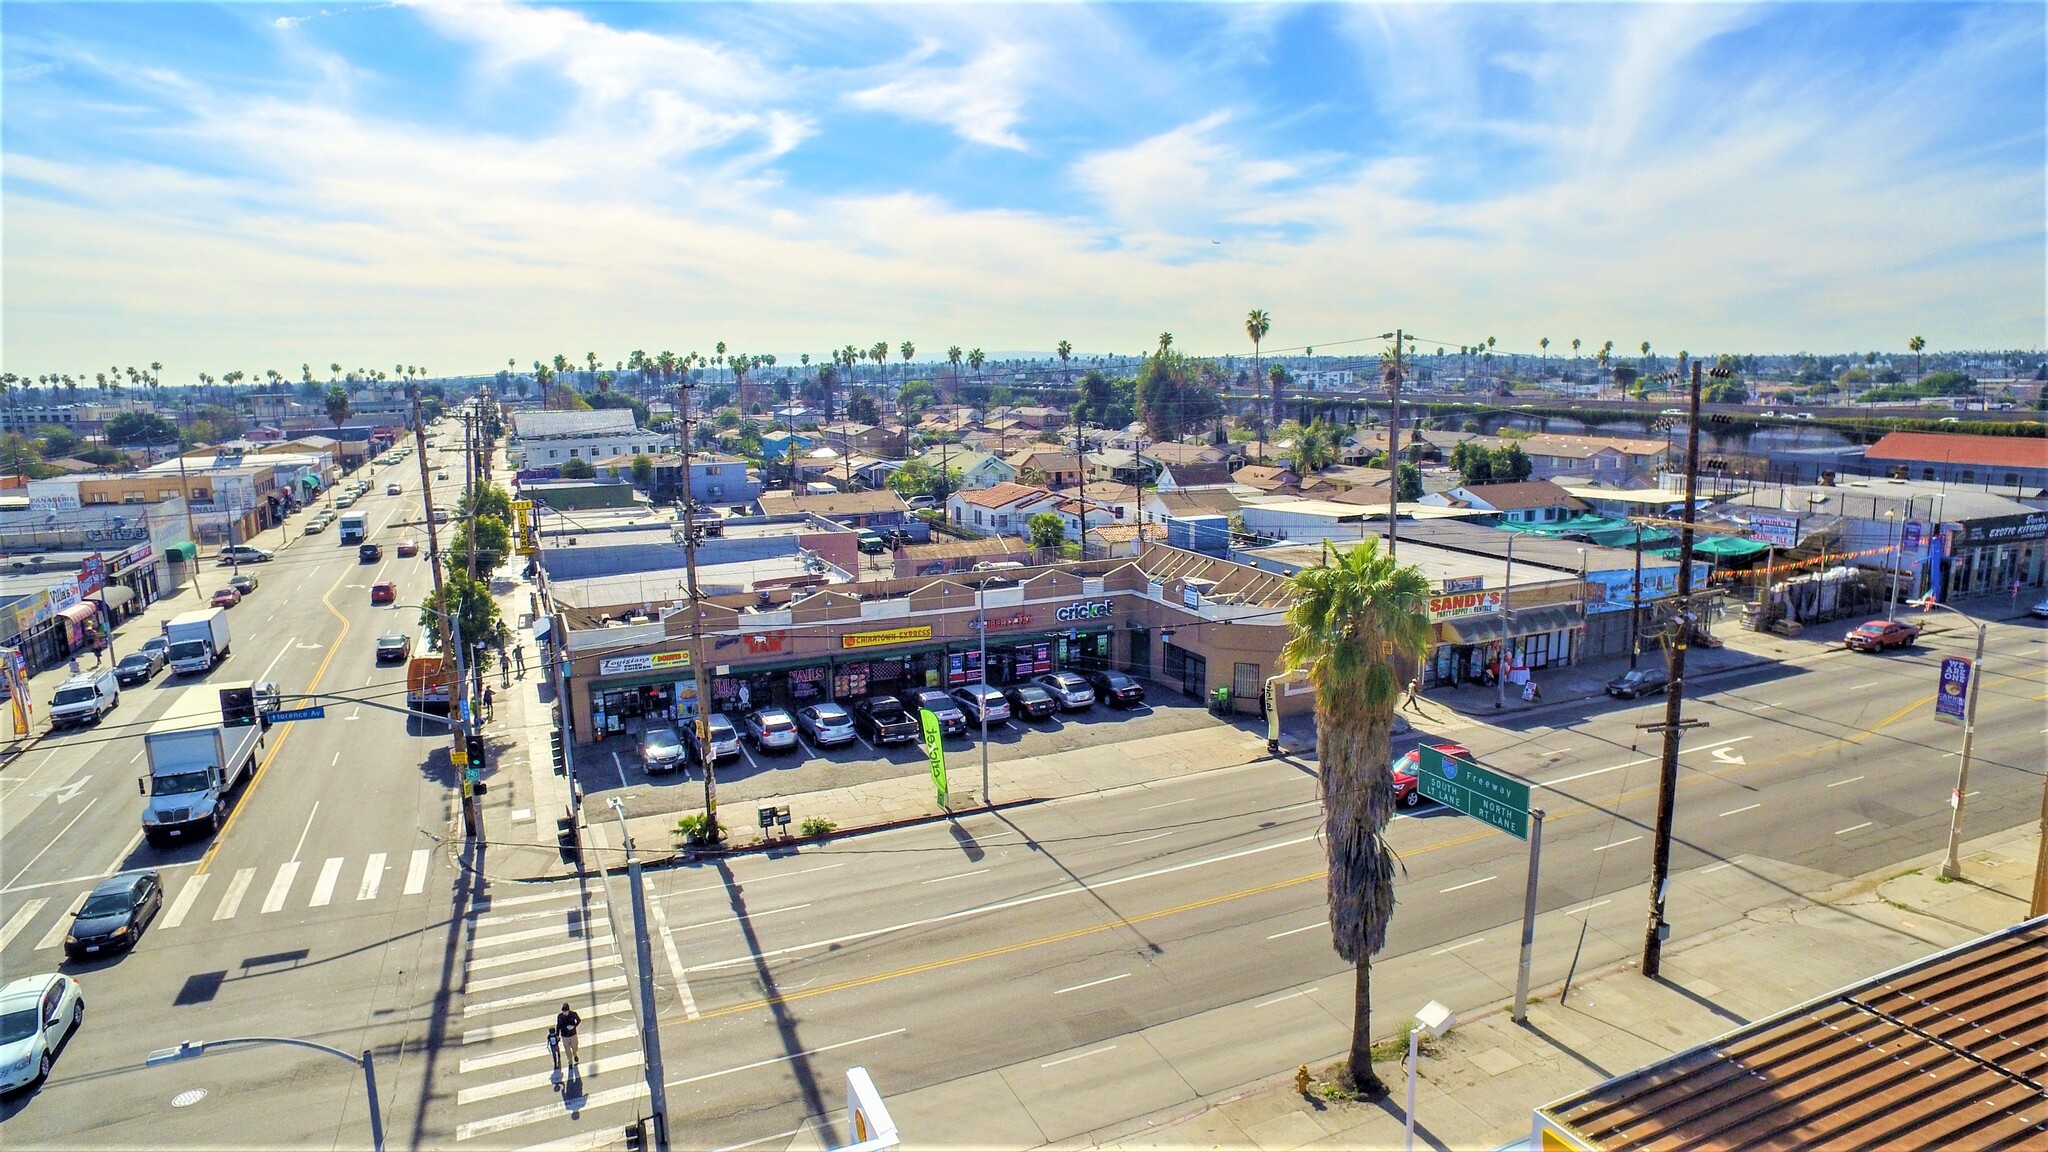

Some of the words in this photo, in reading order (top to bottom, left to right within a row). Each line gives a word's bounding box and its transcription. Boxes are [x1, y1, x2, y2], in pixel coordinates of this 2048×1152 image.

[1989, 527, 2017, 537] EXOTIC
[2017, 523, 2048, 534] KITCHEN
[1776, 536, 1788, 544] TILE
[49, 588, 71, 605] Villa's
[1430, 591, 1500, 612] SANDY'S
[1056, 599, 1114, 621] cricket
[1437, 610, 1451, 618] PARTY
[1452, 608, 1469, 616] SUPPLY
[1473, 605, 1492, 613] RENTALS
[856, 634, 896, 643] CHINATOWN
[899, 628, 931, 638] EXPRESS
[603, 657, 650, 669] Louisiana
[657, 652, 682, 662] DONUTS
[1949, 660, 1965, 669] WE
[789, 668, 825, 682] NAILS
[1944, 672, 1966, 683] ONE
[1945, 667, 1966, 676] ARE
[713, 678, 739, 693] NAILS
[272, 711, 308, 720] Florence
[926, 728, 940, 778] cricket
[1431, 778, 1457, 795] SOUTH
[1466, 772, 1511, 799] Freeway
[1427, 786, 1435, 795] LT
[1440, 791, 1460, 807] LANE
[1483, 800, 1512, 819] NORTH
[1479, 808, 1489, 819] RT
[1492, 814, 1516, 832] LANE
